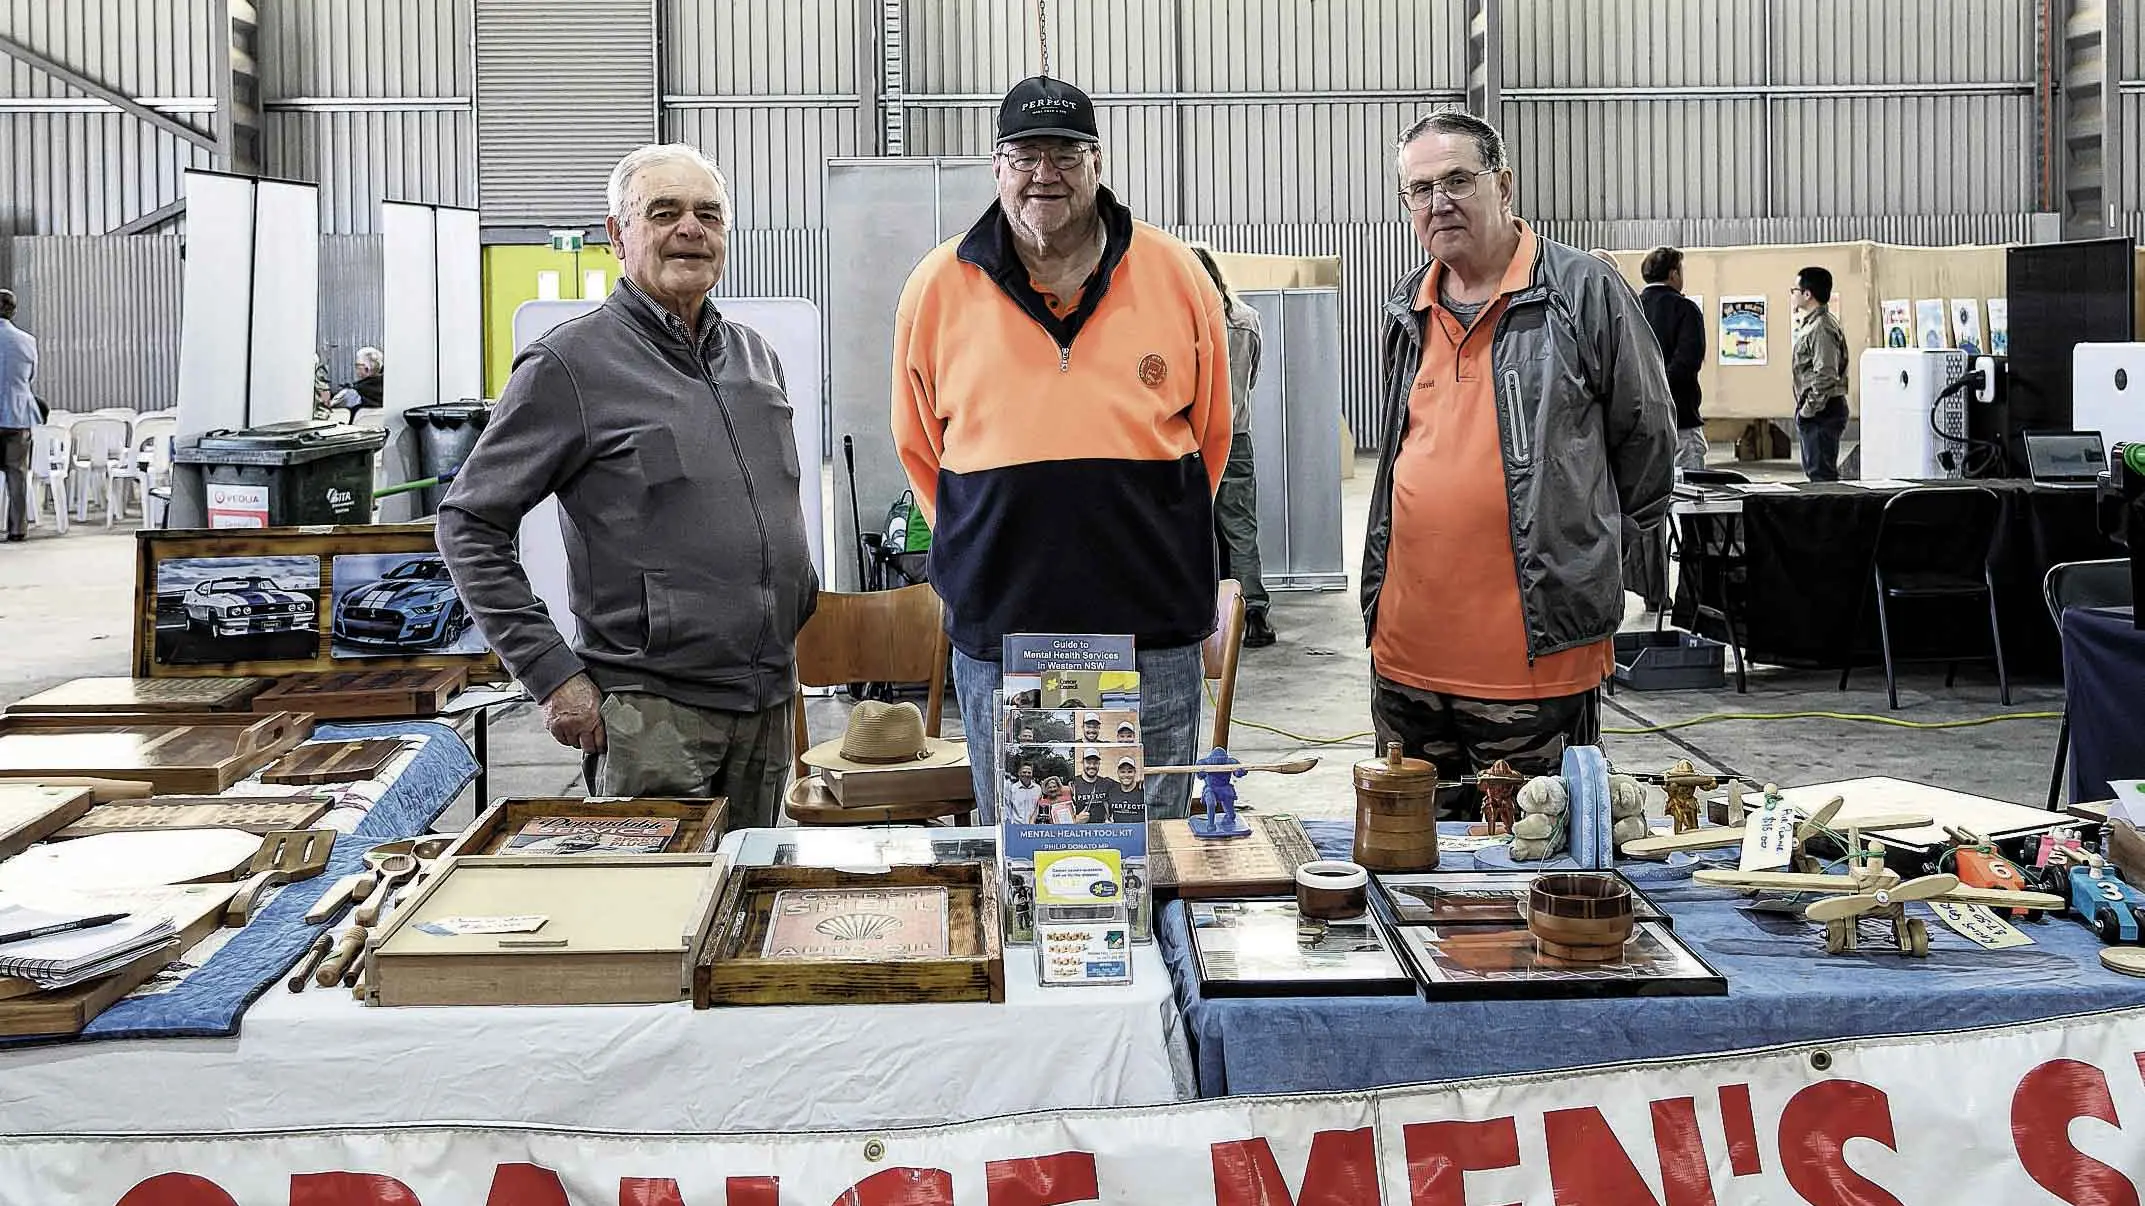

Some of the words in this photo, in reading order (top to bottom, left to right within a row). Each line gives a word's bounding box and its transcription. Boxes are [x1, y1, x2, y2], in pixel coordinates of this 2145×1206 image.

[1021, 99, 1077, 112] PERFECT
[1053, 640, 1078, 649] Guide
[1080, 640, 1089, 649] to
[1023, 651, 1051, 660] Mental
[1053, 651, 1081, 660] Health
[1082, 651, 1119, 660] Services
[1037, 661, 1046, 670] in
[1048, 662, 1082, 670] Western
[1084, 661, 1106, 670] NSW
[539, 827, 660, 836] SERVICE
[1021, 830, 1056, 839] MENTAL
[1058, 829, 1092, 838] HEALTH
[1094, 829, 1118, 837] TOOL
[1120, 828, 1134, 837] KIT
[1989, 861, 2012, 879] 6
[2096, 881, 2125, 901] 3
[784, 901, 938, 916] SHELL
[2011, 1051, 2145, 1206] S
